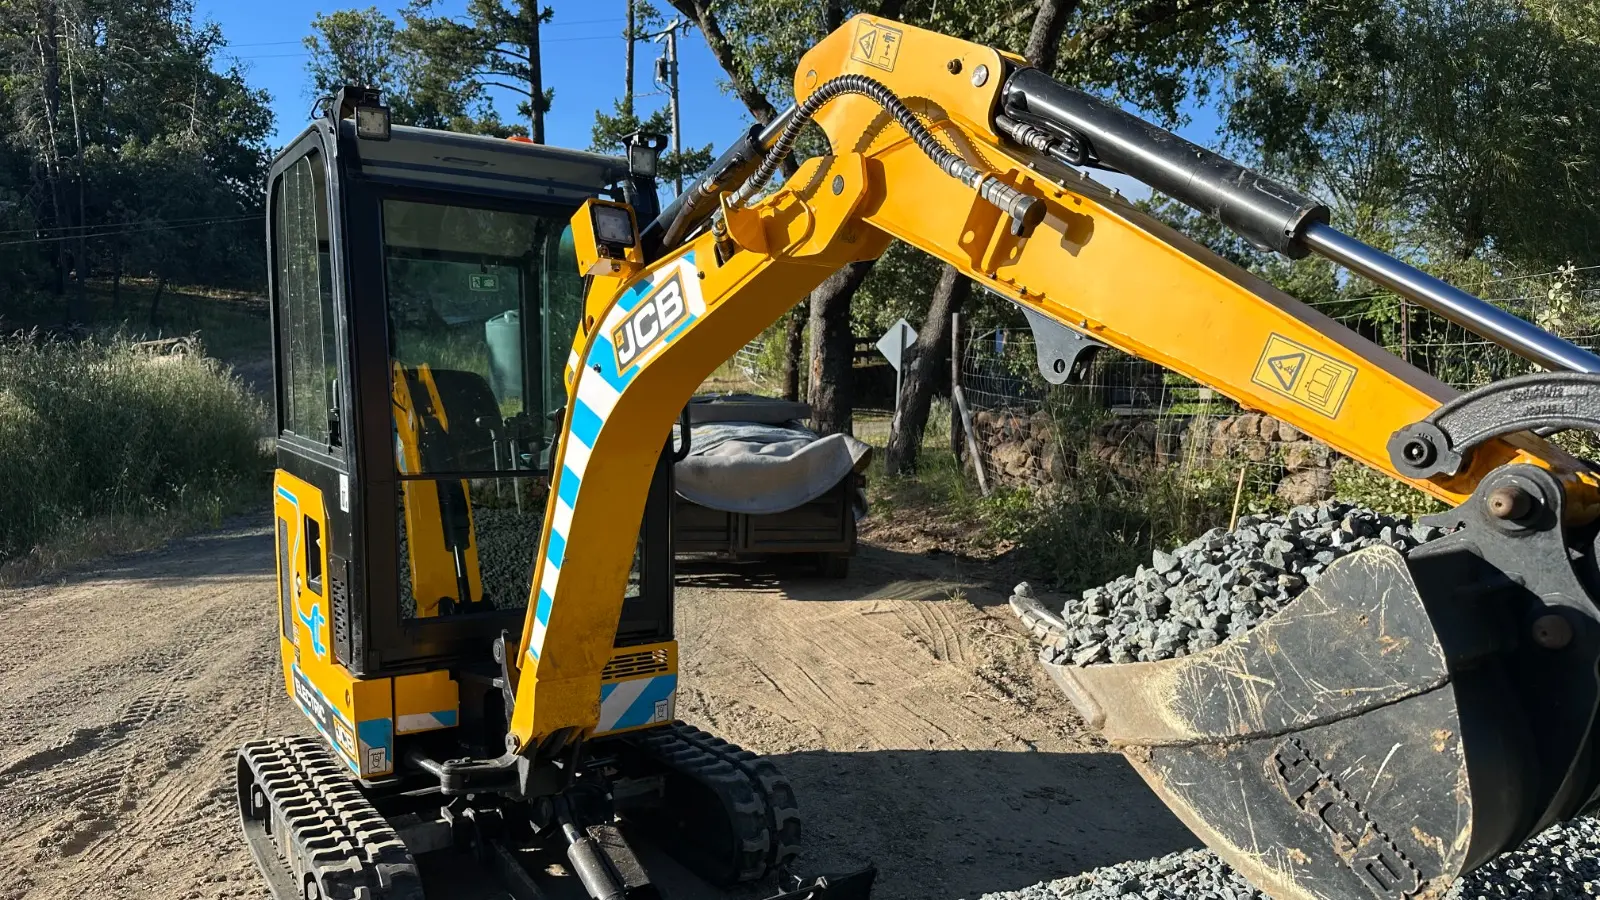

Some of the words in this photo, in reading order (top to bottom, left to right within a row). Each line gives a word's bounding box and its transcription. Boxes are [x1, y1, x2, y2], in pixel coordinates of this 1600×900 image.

[618, 280, 684, 365] JCB
[294, 676, 327, 724] ELECTRIC
[335, 723, 356, 757] JCB
[1266, 738, 1421, 899] JCB
